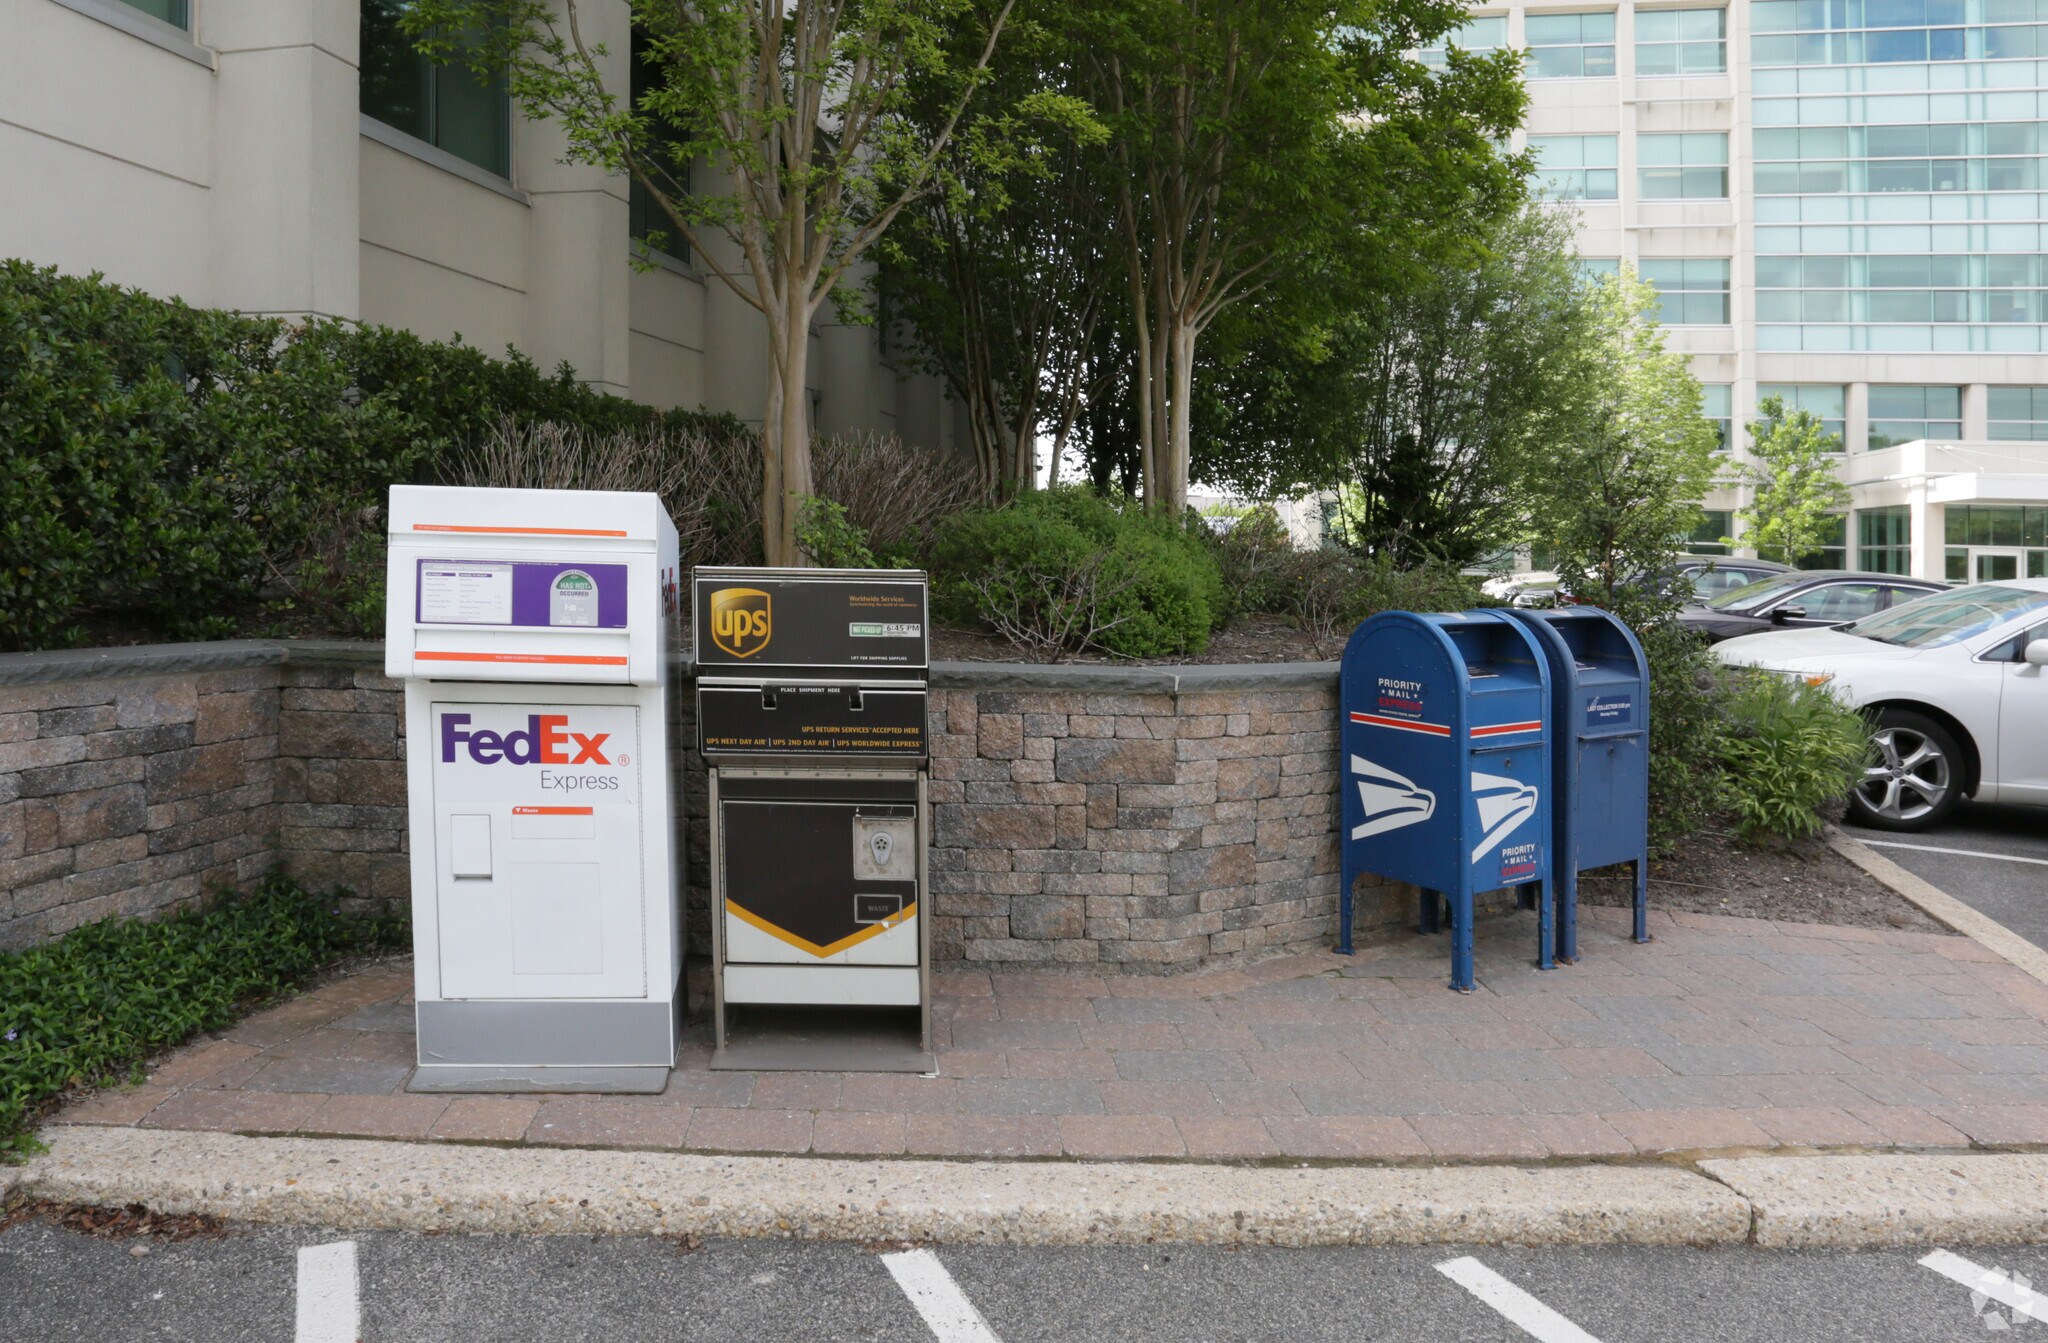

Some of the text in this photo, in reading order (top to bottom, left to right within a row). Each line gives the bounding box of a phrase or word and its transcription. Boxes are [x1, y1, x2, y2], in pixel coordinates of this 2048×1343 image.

[560, 582, 573, 590] HAS
[849, 595, 879, 603] Worldwide
[715, 609, 768, 648] ups
[886, 624, 920, 632] 6:45 PM
[1378, 677, 1422, 692] PRIORITY
[1388, 689, 1411, 699] MAIL
[1586, 705, 1597, 713] LAST
[441, 713, 611, 765] FedEx
[541, 770, 619, 793] Express
[1502, 843, 1535, 857] PRIORITY
[1510, 855, 1527, 864] MAIL
[867, 904, 889, 912] WASTE
